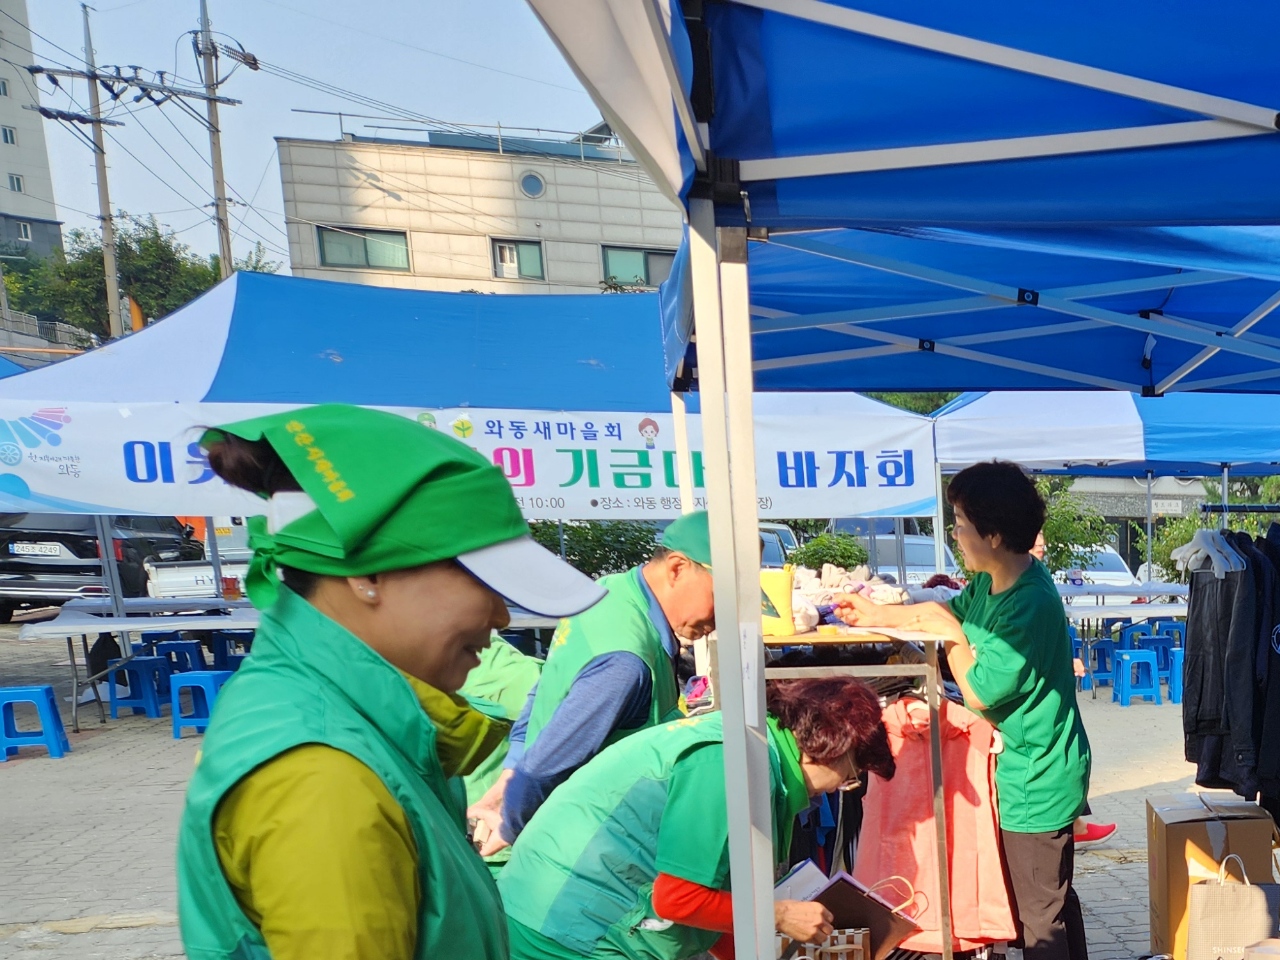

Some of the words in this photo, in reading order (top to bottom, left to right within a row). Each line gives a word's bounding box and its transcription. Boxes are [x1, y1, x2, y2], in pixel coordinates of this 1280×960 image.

[485, 419, 622, 442] 와동새마을회
[58, 464, 82, 479] 와동
[493, 447, 536, 488] 의
[558, 447, 706, 490] 기금마
[776, 447, 916, 490] 바자회
[515, 496, 526, 510] 전
[529, 497, 566, 509] 10:00
[600, 496, 624, 511] 장소
[633, 496, 657, 510] 와동
[38, 546, 58, 554] 4249
